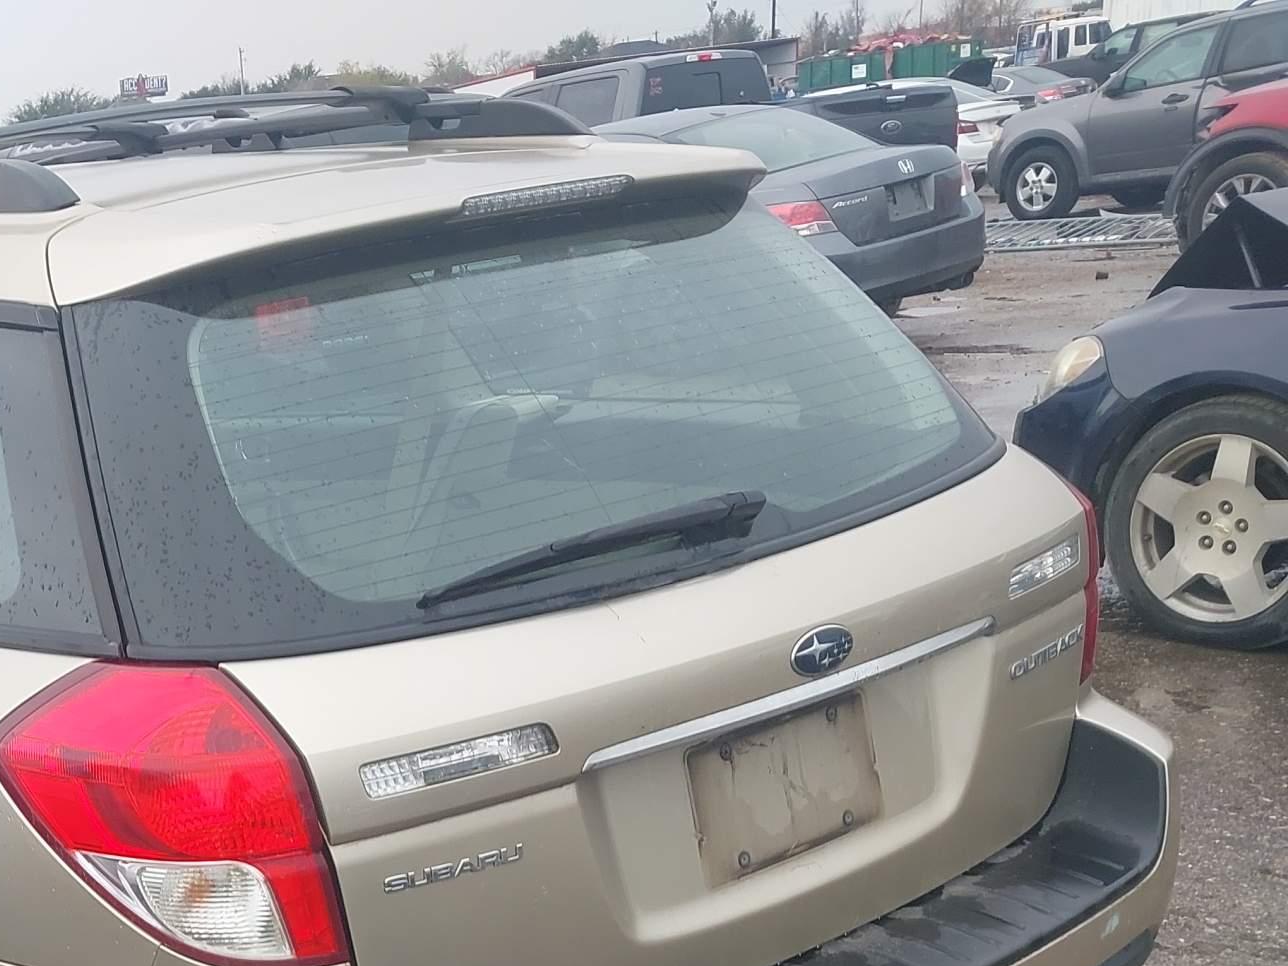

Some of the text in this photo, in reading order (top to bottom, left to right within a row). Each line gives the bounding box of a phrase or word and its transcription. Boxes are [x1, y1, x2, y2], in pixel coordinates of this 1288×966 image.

[832, 196, 868, 208] Accord
[1009, 623, 1083, 680] OUTBACK
[383, 843, 523, 894] SUBARU
